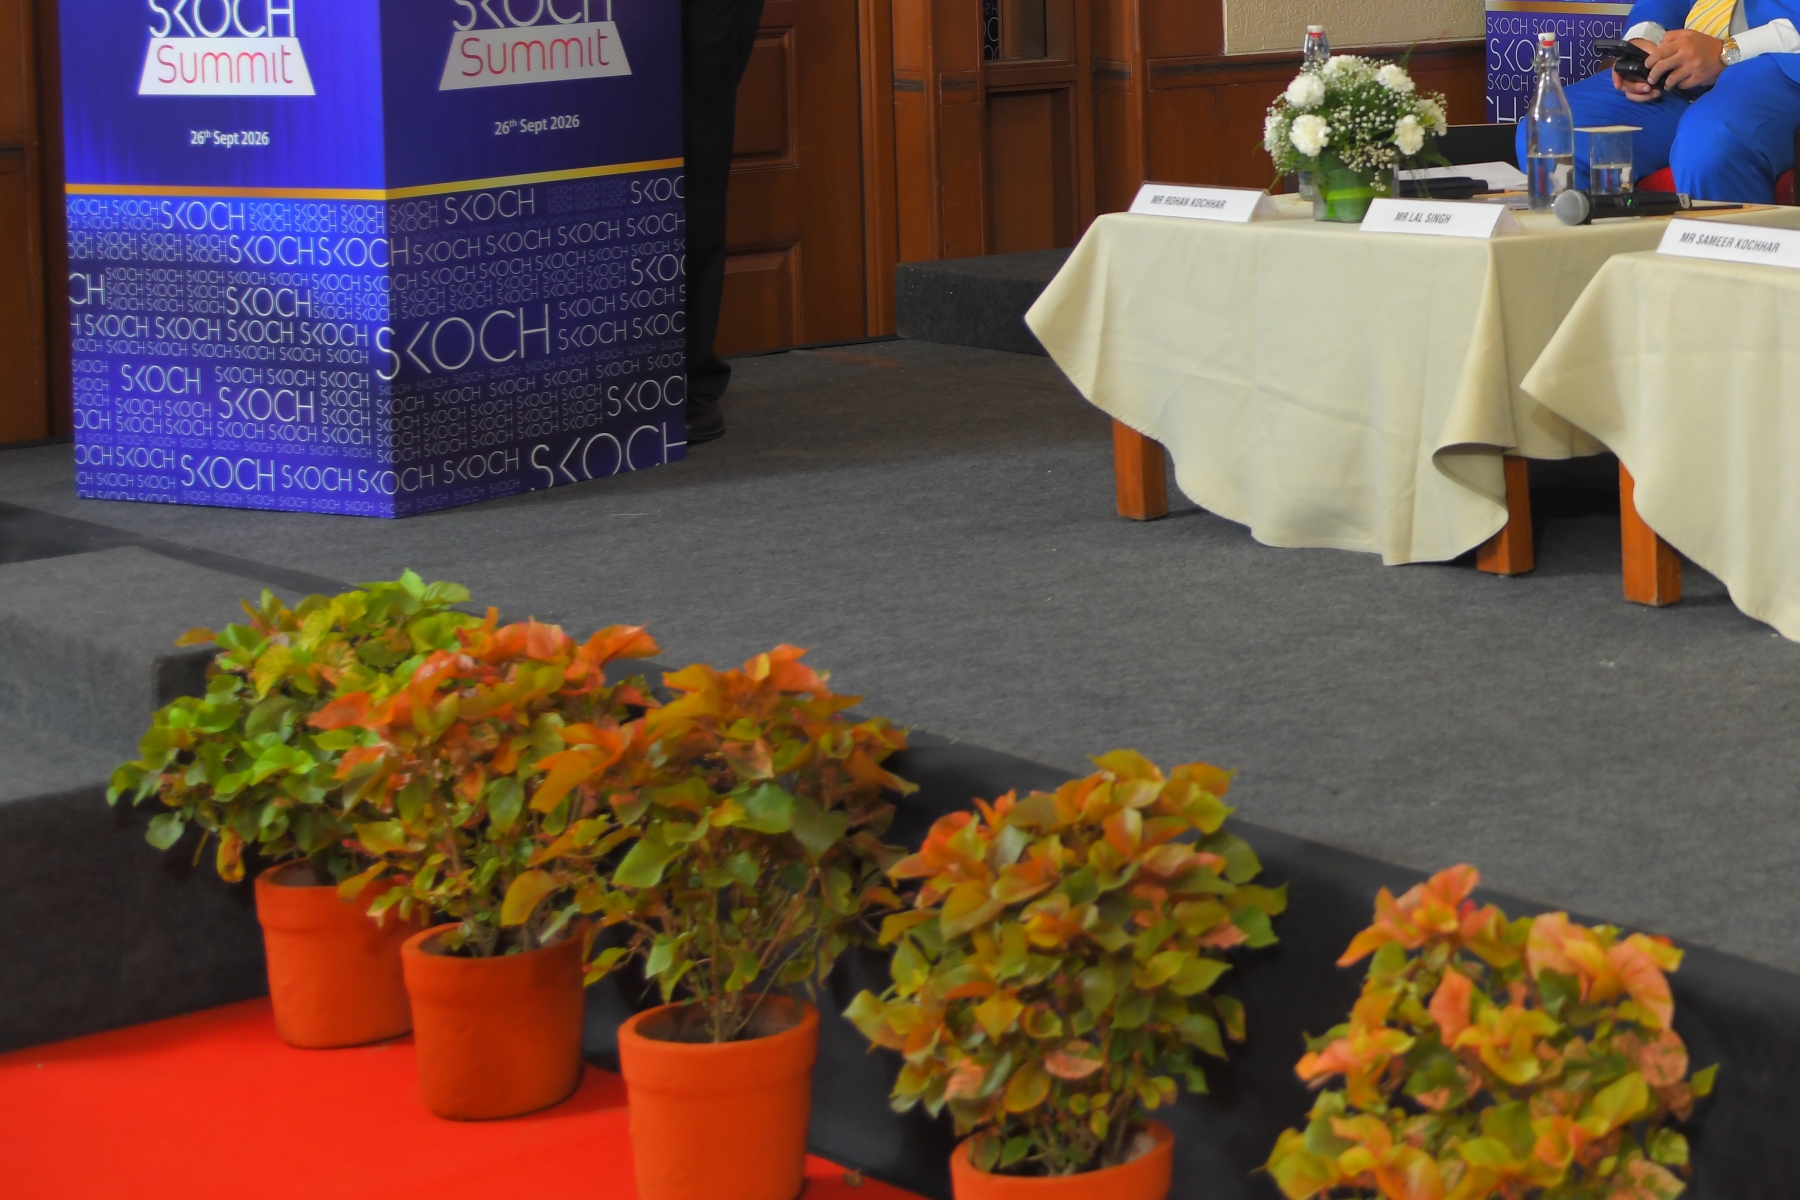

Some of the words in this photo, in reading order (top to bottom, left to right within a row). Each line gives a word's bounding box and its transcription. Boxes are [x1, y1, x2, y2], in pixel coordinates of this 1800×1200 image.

[1487, 16, 1528, 35] SKOCH
[460, 28, 610, 77] Summit
[1490, 37, 1573, 75] SKOH
[156, 44, 293, 84] Summit
[494, 118, 518, 136] 26th
[520, 118, 548, 135] Sept
[550, 114, 580, 131] 2026
[190, 129, 211, 146] 26th
[213, 130, 240, 149] Sept
[241, 130, 271, 146] 2026
[1150, 194, 1165, 205] MR
[1163, 195, 1191, 207] ROHAN
[1189, 197, 1227, 209] KOCHHAR
[1394, 211, 1409, 222] MR
[1408, 212, 1424, 223] LAL
[1424, 212, 1452, 224] SINGH
[1679, 231, 1696, 243] MR
[1695, 233, 1735, 249] SAMEER
[1734, 238, 1780, 253] KOCHHAR
[376, 304, 550, 381] SKOCH
